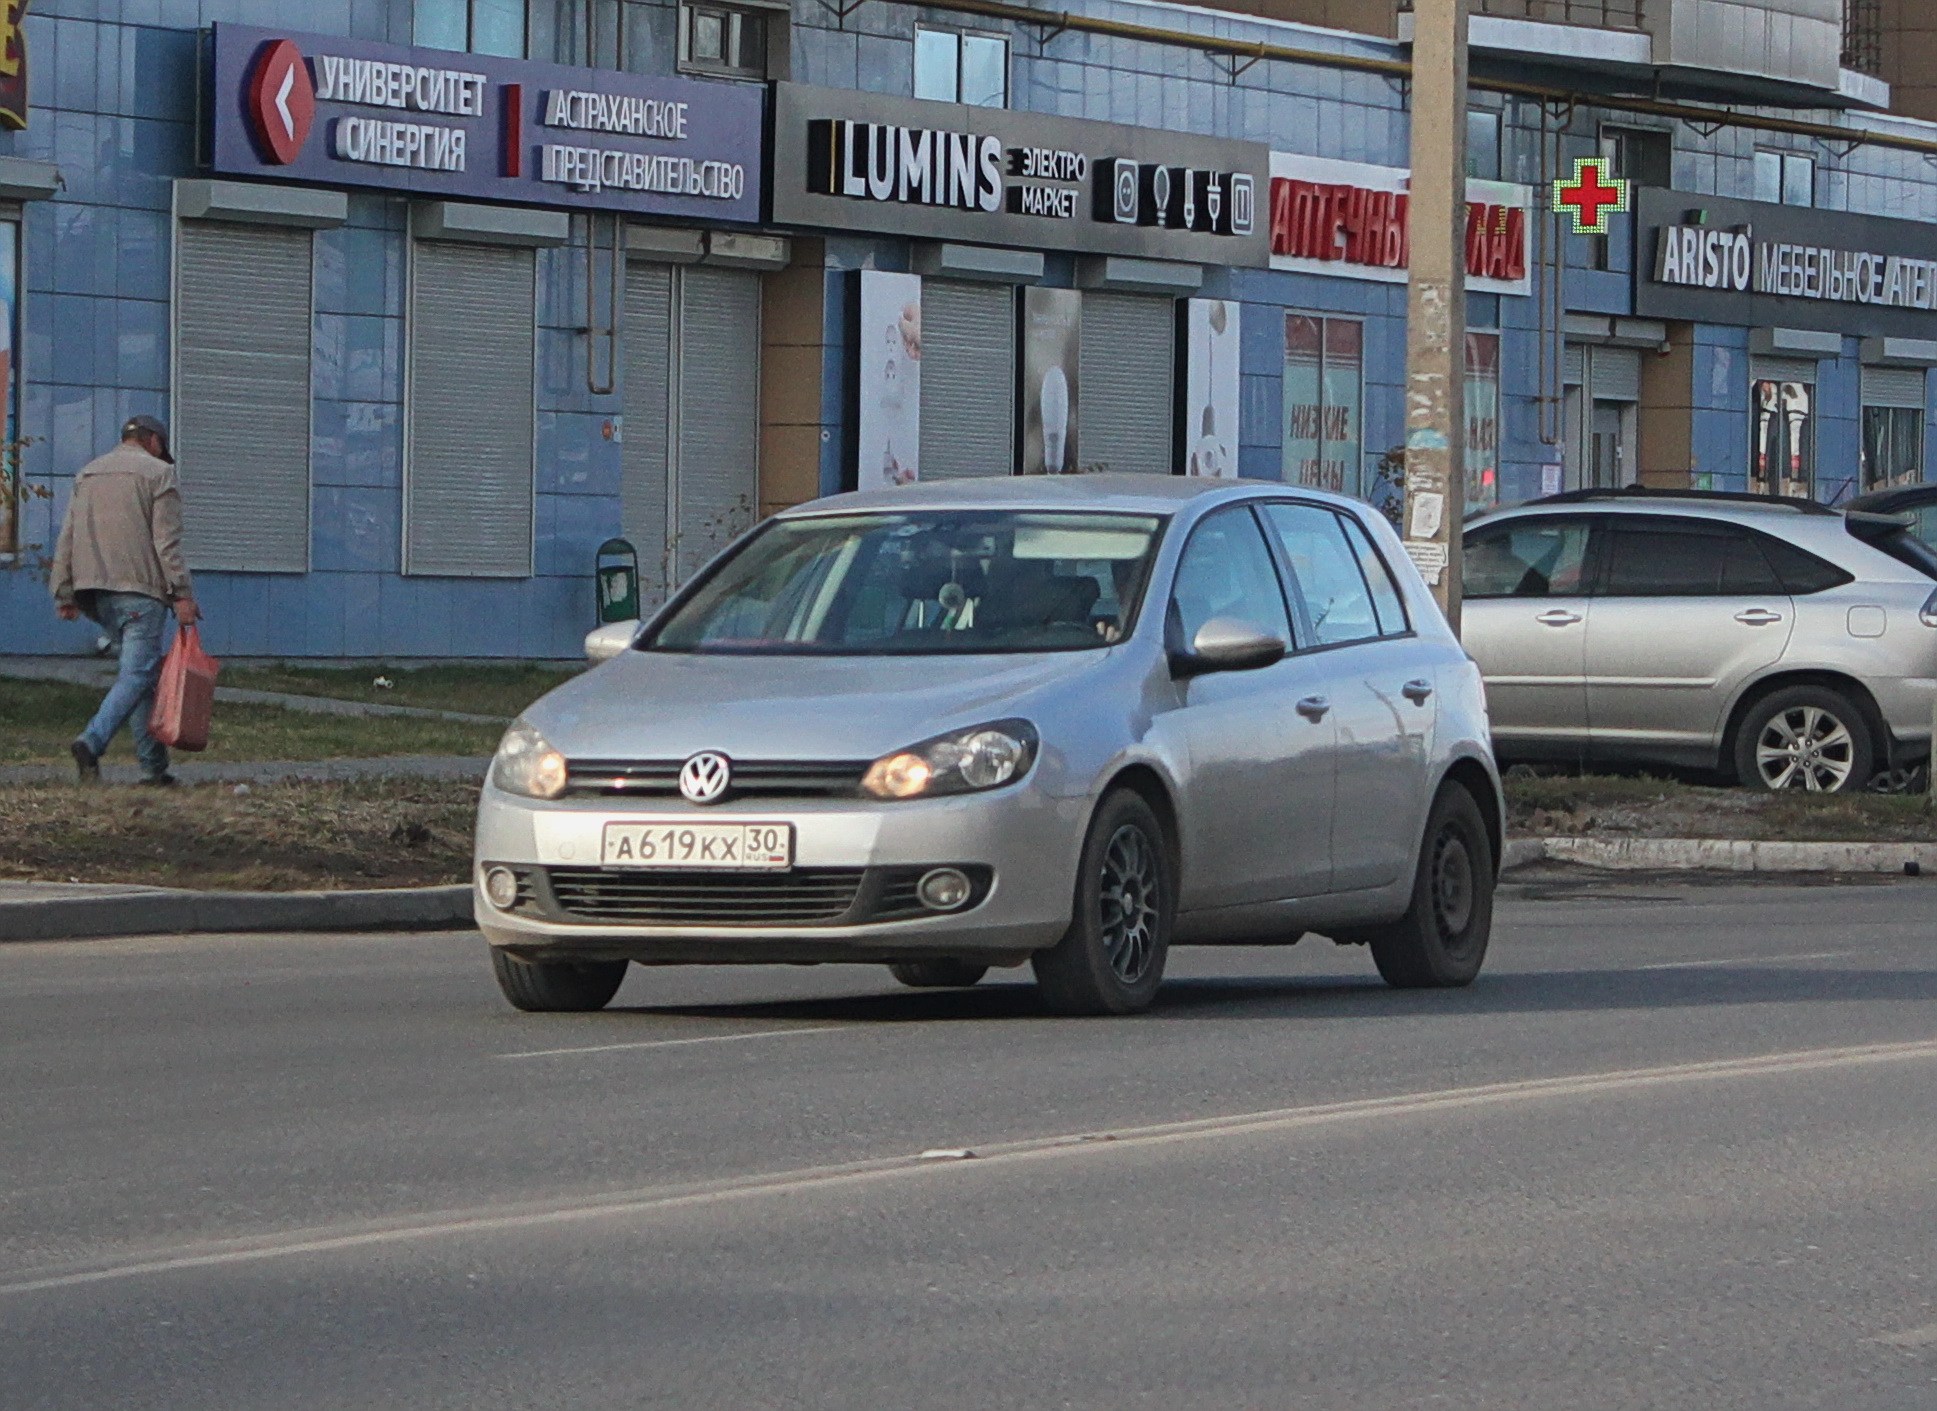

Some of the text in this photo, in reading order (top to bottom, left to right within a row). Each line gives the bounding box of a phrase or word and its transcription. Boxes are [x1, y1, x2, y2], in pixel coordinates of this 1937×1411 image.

[315, 55, 487, 116] УНИВЕРСИТЕТ
[549, 89, 689, 139] АСТРАХАНСКОЕ
[339, 116, 467, 172] СИНЕРГИЯ
[548, 144, 745, 200] ПРЕДСТАВИТЕЛЬСТВО
[1021, 147, 1087, 182] ЭЛЕКТРО
[1021, 185, 1080, 219] МАРКЕТ
[1270, 177, 1411, 270] АПТЕЧНЫ
[1660, 223, 1753, 292] ARISTO
[1760, 241, 1884, 304] МЕБЕЛЬНОЕ
[1289, 403, 1350, 441] НИЗКИЕ
[747, 828, 779, 853] 30
